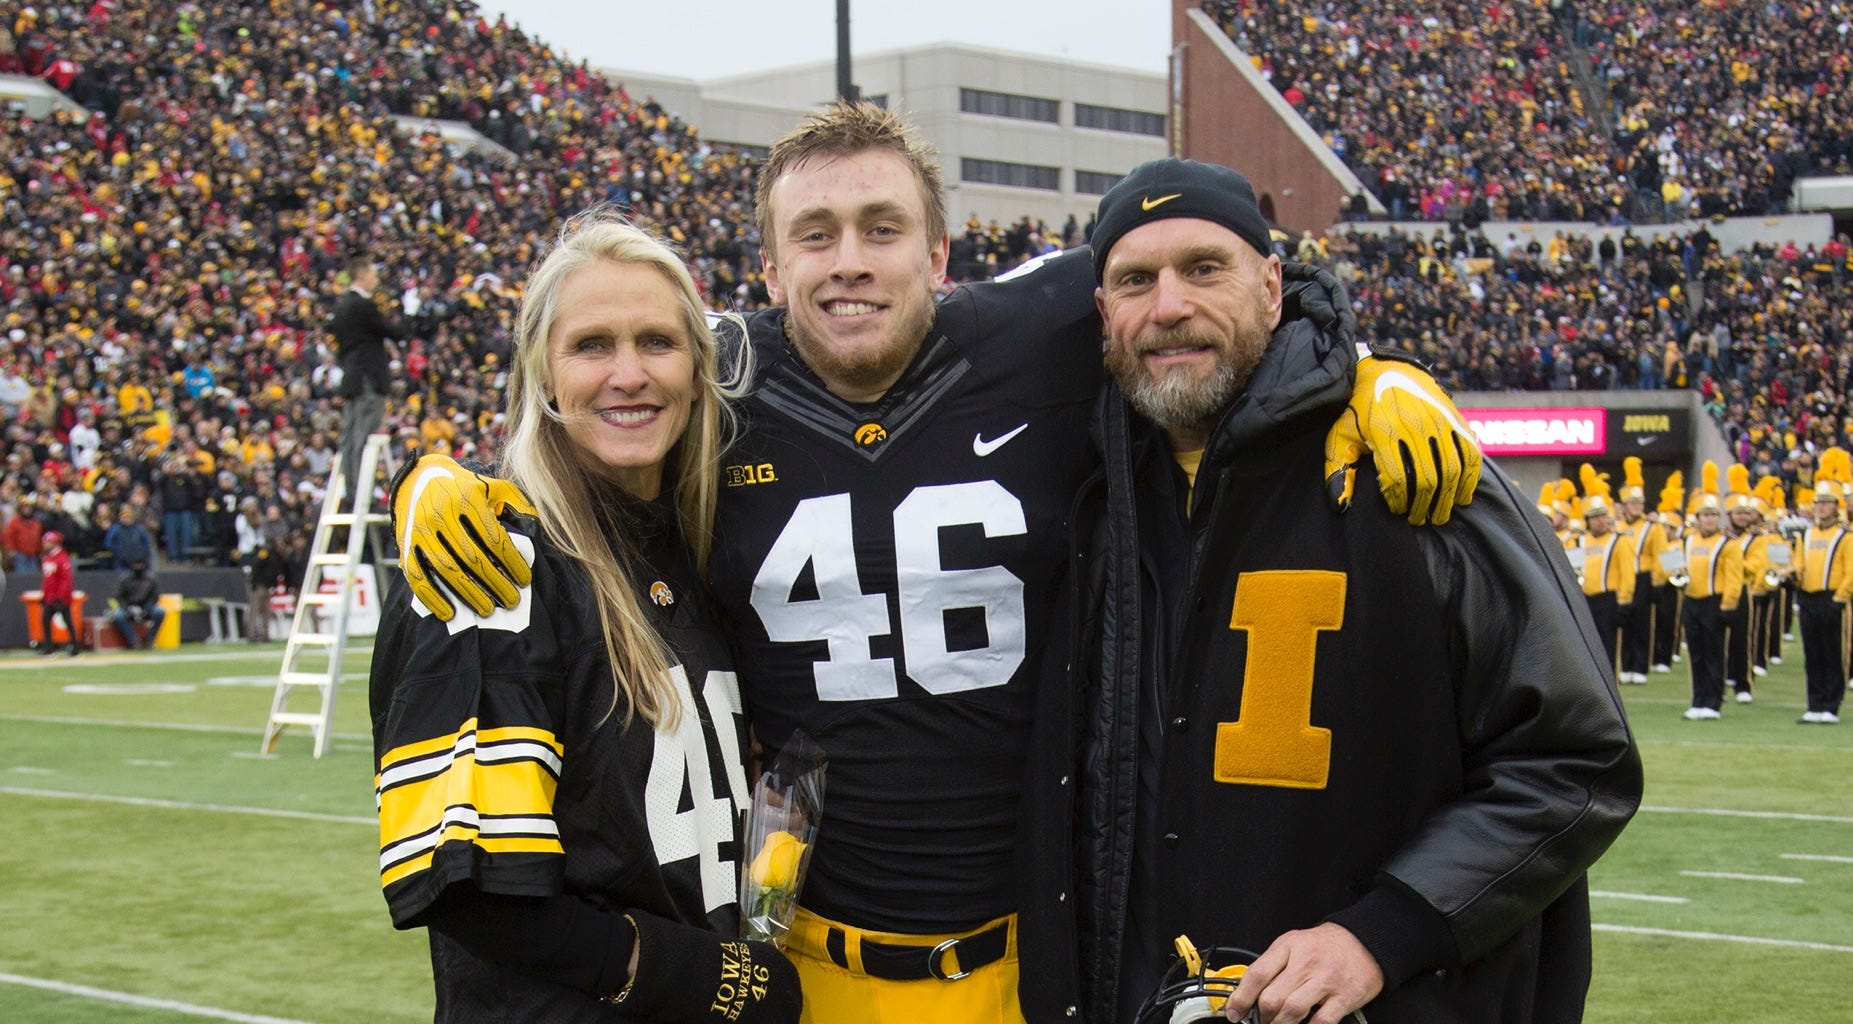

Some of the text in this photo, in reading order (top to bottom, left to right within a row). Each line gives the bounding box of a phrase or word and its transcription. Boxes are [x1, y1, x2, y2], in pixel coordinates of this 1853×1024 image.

[750, 479, 1028, 702] 46
[1214, 569, 1347, 789] I
[710, 941, 741, 1016] IOWA
[751, 964, 770, 1002] 46
